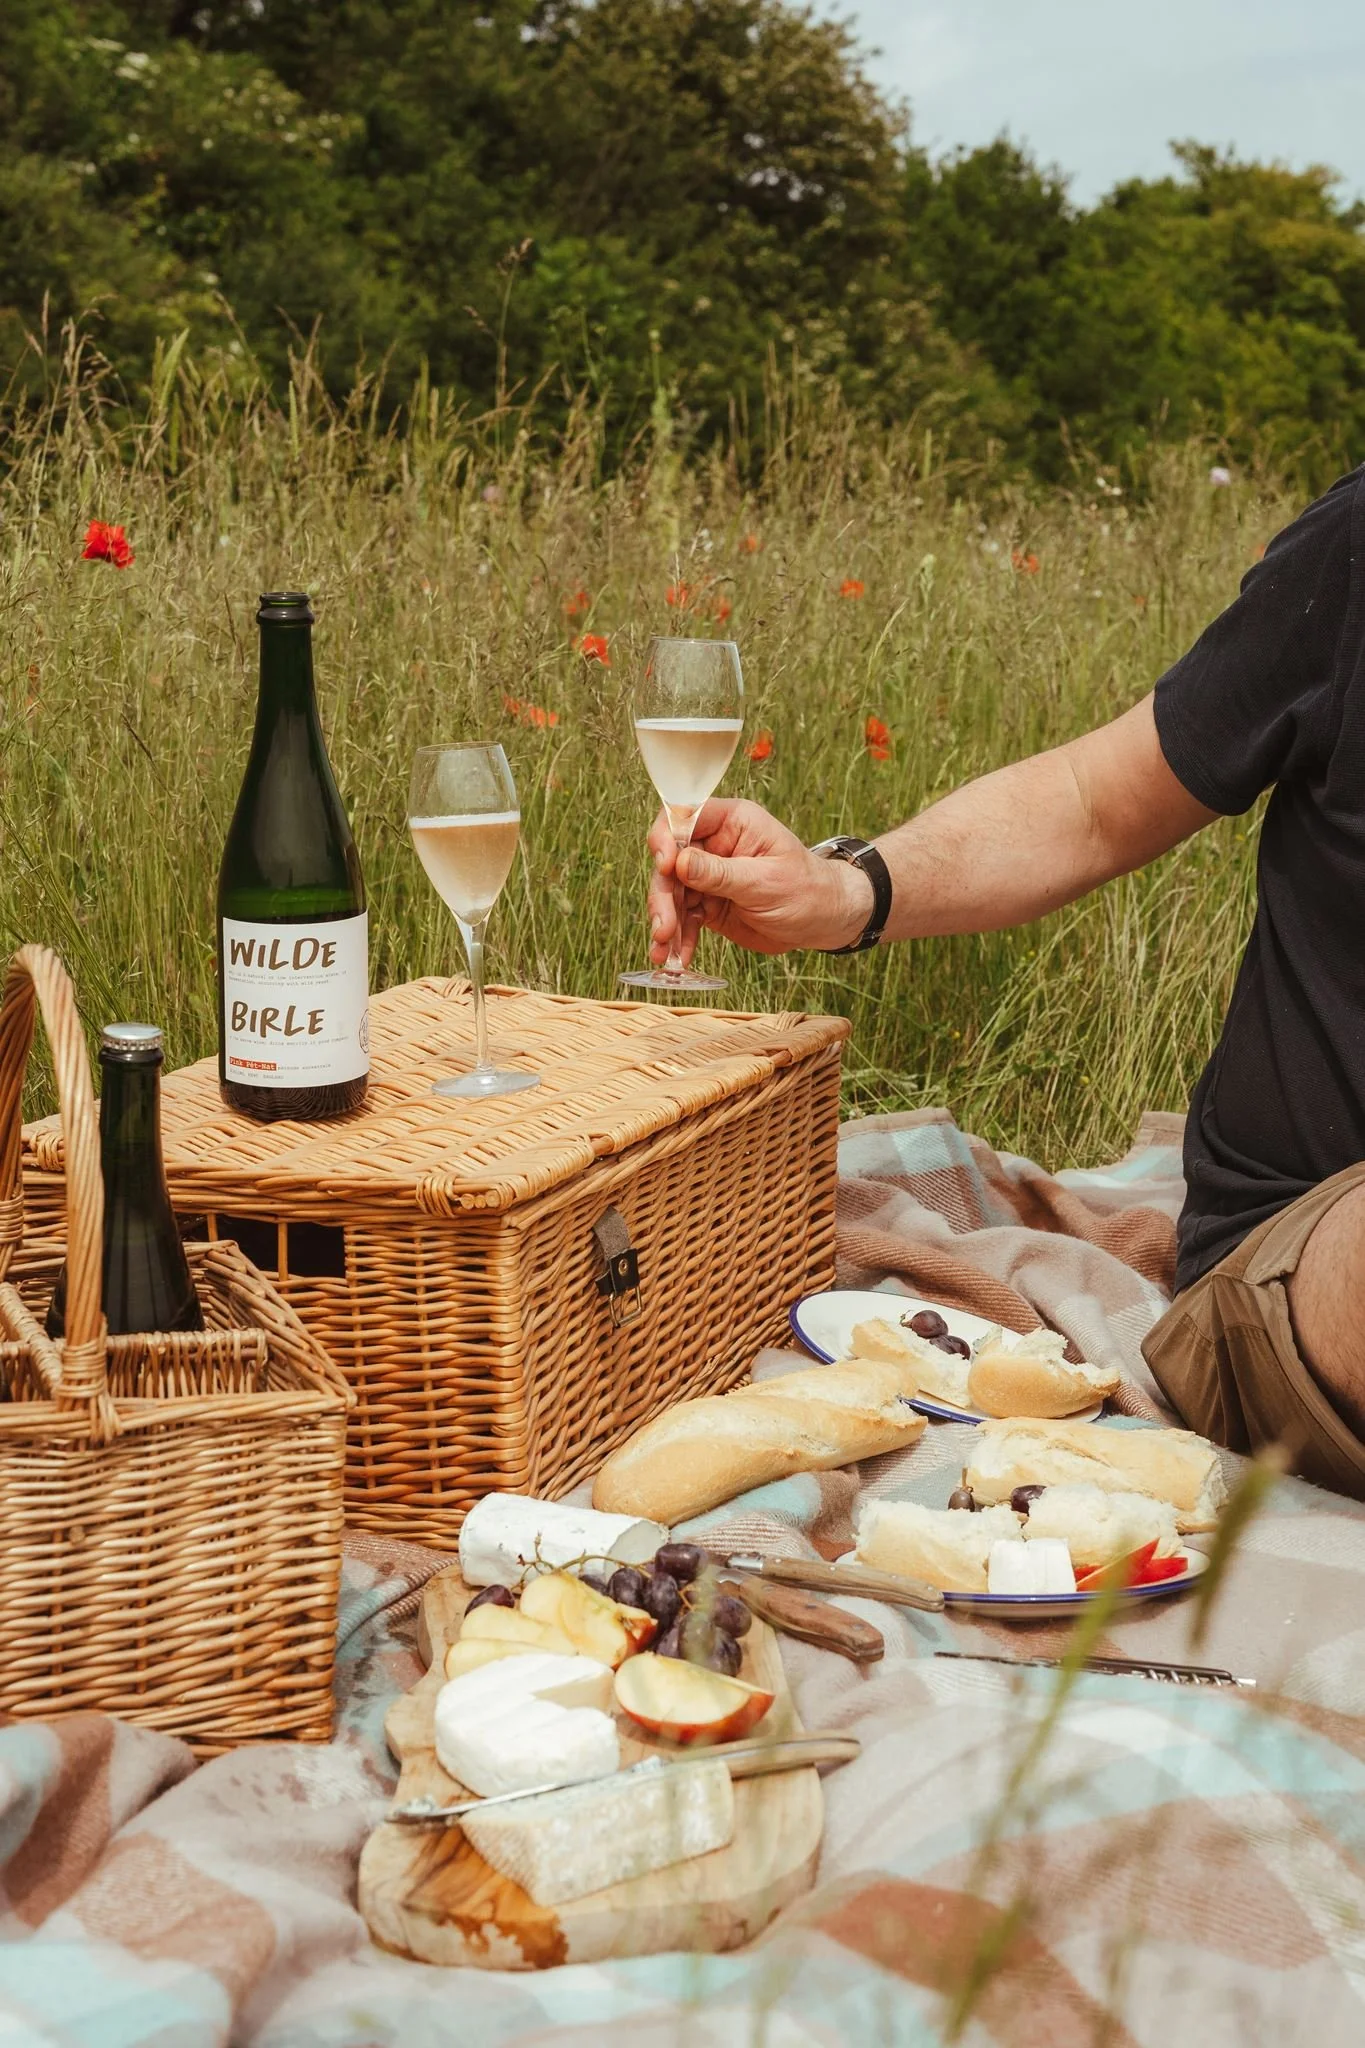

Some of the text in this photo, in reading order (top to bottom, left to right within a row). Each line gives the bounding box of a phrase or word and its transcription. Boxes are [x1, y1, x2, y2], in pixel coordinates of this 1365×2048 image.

[231, 938, 337, 970] WILDE
[232, 1001, 325, 1038] BIRLE
[230, 1057, 243, 1066] Pink
